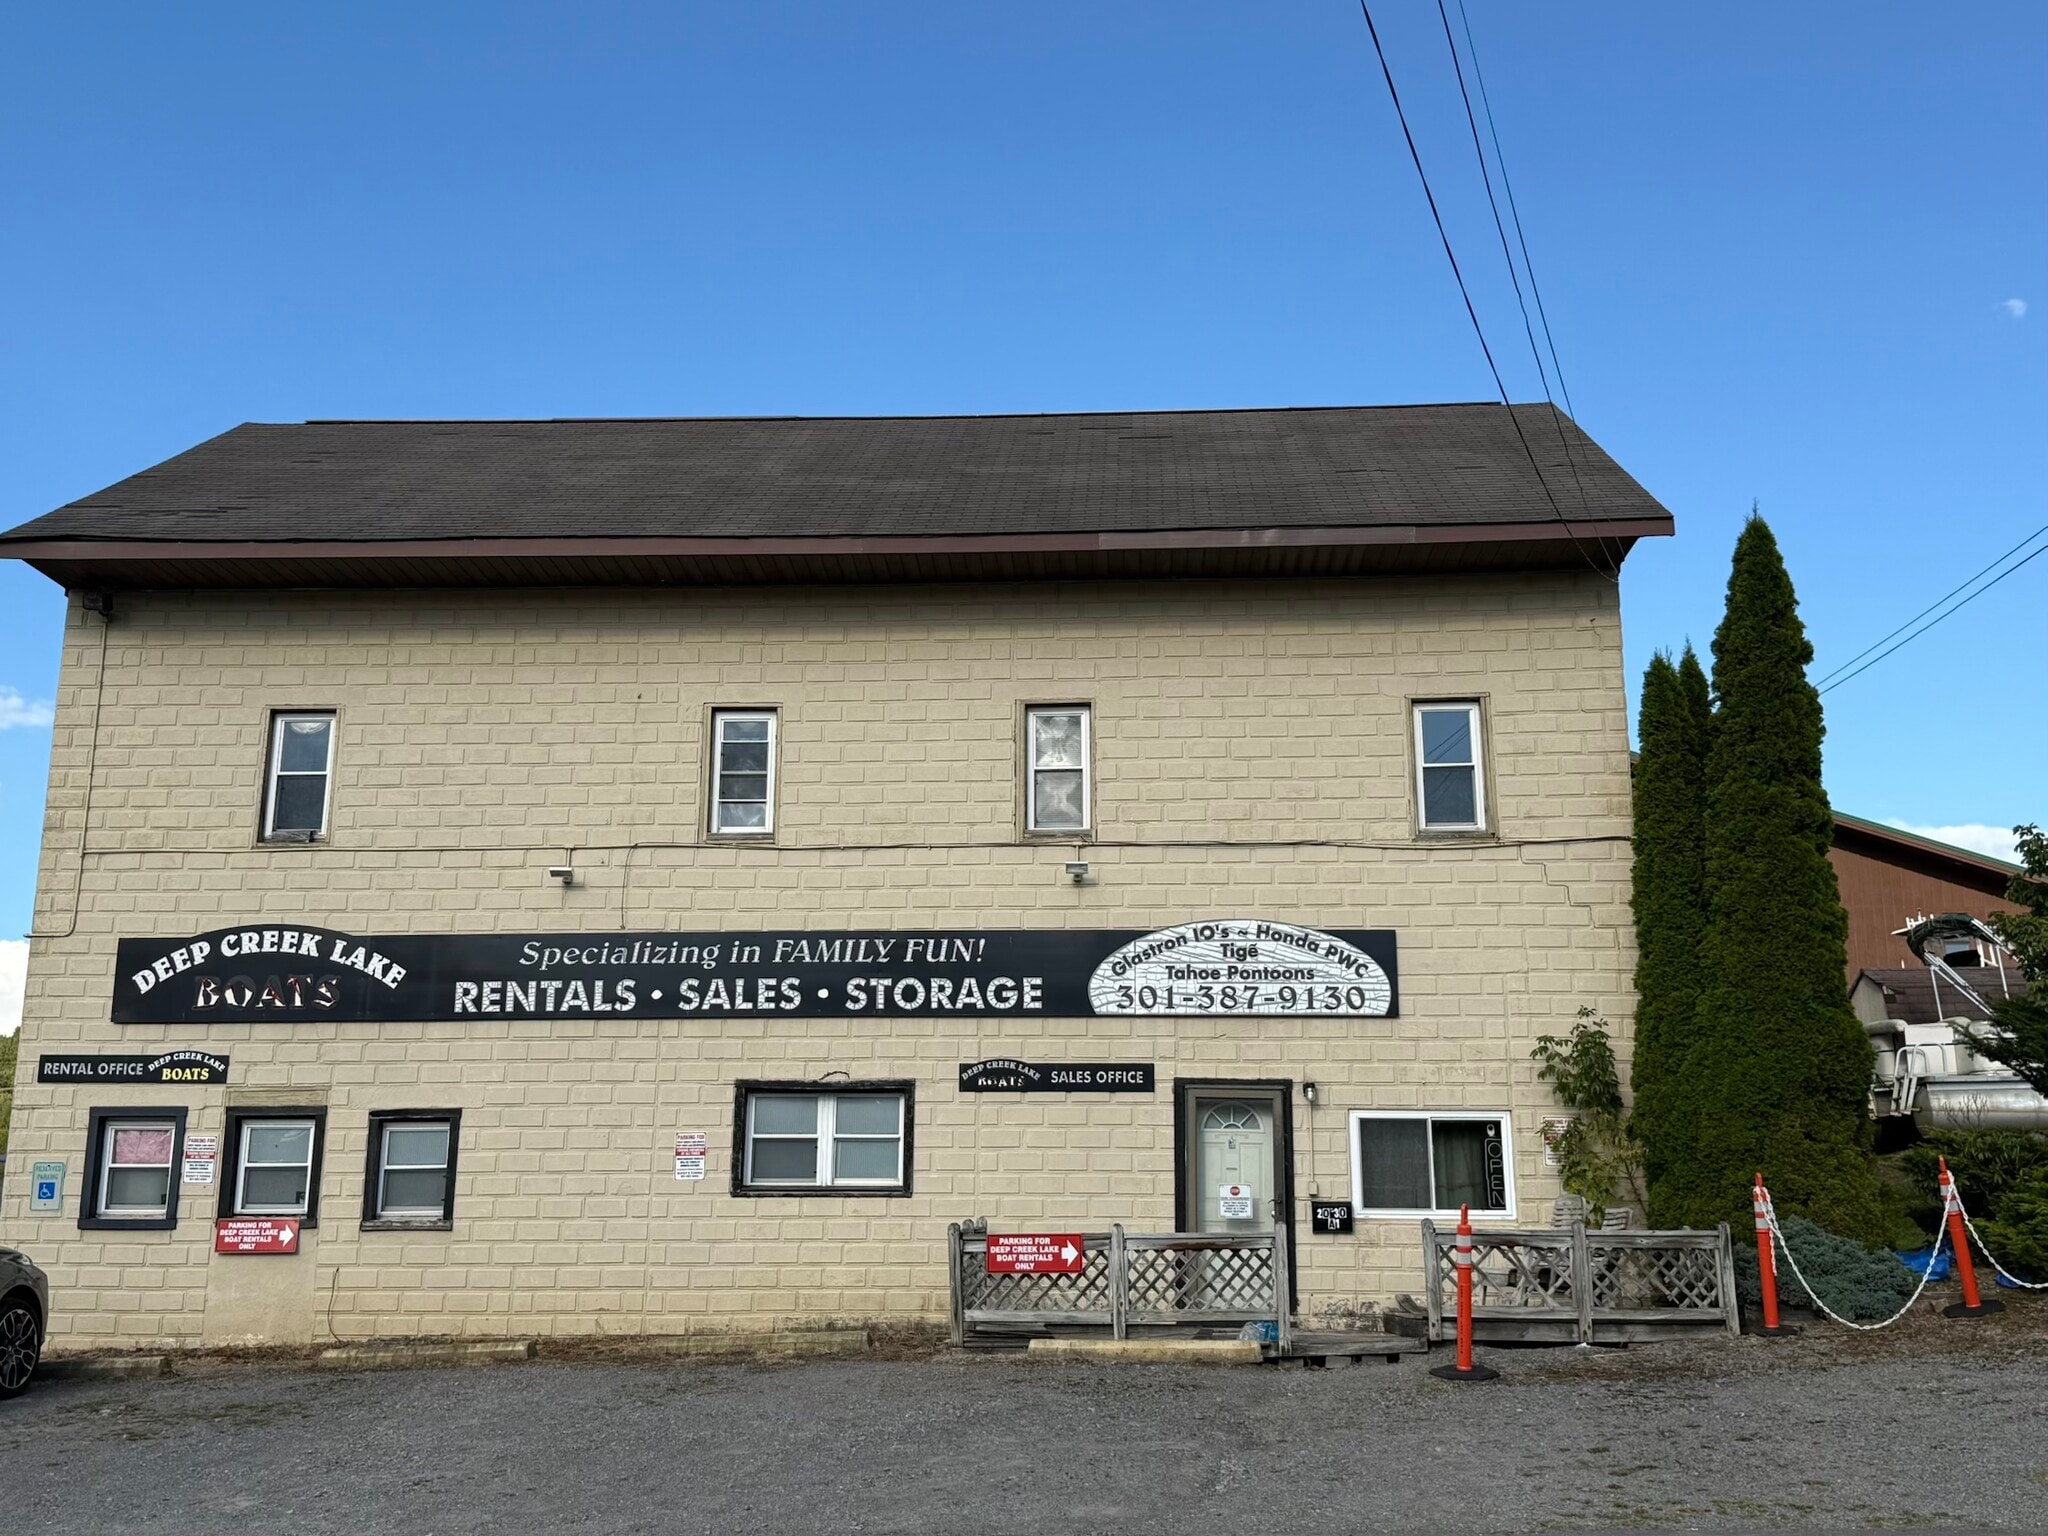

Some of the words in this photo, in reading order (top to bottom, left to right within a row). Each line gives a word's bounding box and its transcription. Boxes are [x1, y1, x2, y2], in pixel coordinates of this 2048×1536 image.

[519, 941, 721, 970] Specializing
[729, 940, 761, 964] in
[772, 938, 897, 963] FAMILY
[903, 938, 986, 963] FUN!
[1111, 932, 1188, 977] Glastron
[1256, 924, 1320, 953] Honda
[1324, 944, 1370, 978] PWC
[132, 940, 211, 994] DEEP
[220, 930, 322, 957] CREEK
[329, 939, 407, 990] LAKE
[1165, 964, 1221, 980] Tahoe
[1227, 965, 1315, 980] Pontoons
[192, 974, 341, 1011] BOATS
[453, 979, 637, 1013] RENTALS
[677, 977, 802, 1011] SALES
[845, 976, 1044, 1010] STORAGE
[1115, 985, 1366, 1010] 301-387-9130
[44, 1062, 93, 1075] RENTAL
[98, 1062, 144, 1075] OFFICE
[148, 1055, 171, 1072] DEEP
[173, 1052, 203, 1061] CREEK
[204, 1055, 226, 1072] LAKE
[961, 1063, 985, 1080] DEEP
[986, 1061, 1016, 1070] CREEK
[1018, 1064, 1041, 1081] LAKE
[161, 1068, 209, 1080] BOATS
[1051, 1071, 1091, 1083] SALES
[1096, 1071, 1144, 1083] OFFICE
[1487, 1142, 1505, 1205] OPEN
[999, 1237, 1033, 1245] PARKING
[1035, 1237, 1051, 1245] FOR
[996, 1254, 1017, 1262] BOAT
[1018, 1254, 1053, 1262] RENTALS
[1014, 1262, 1035, 1270] ONLY
